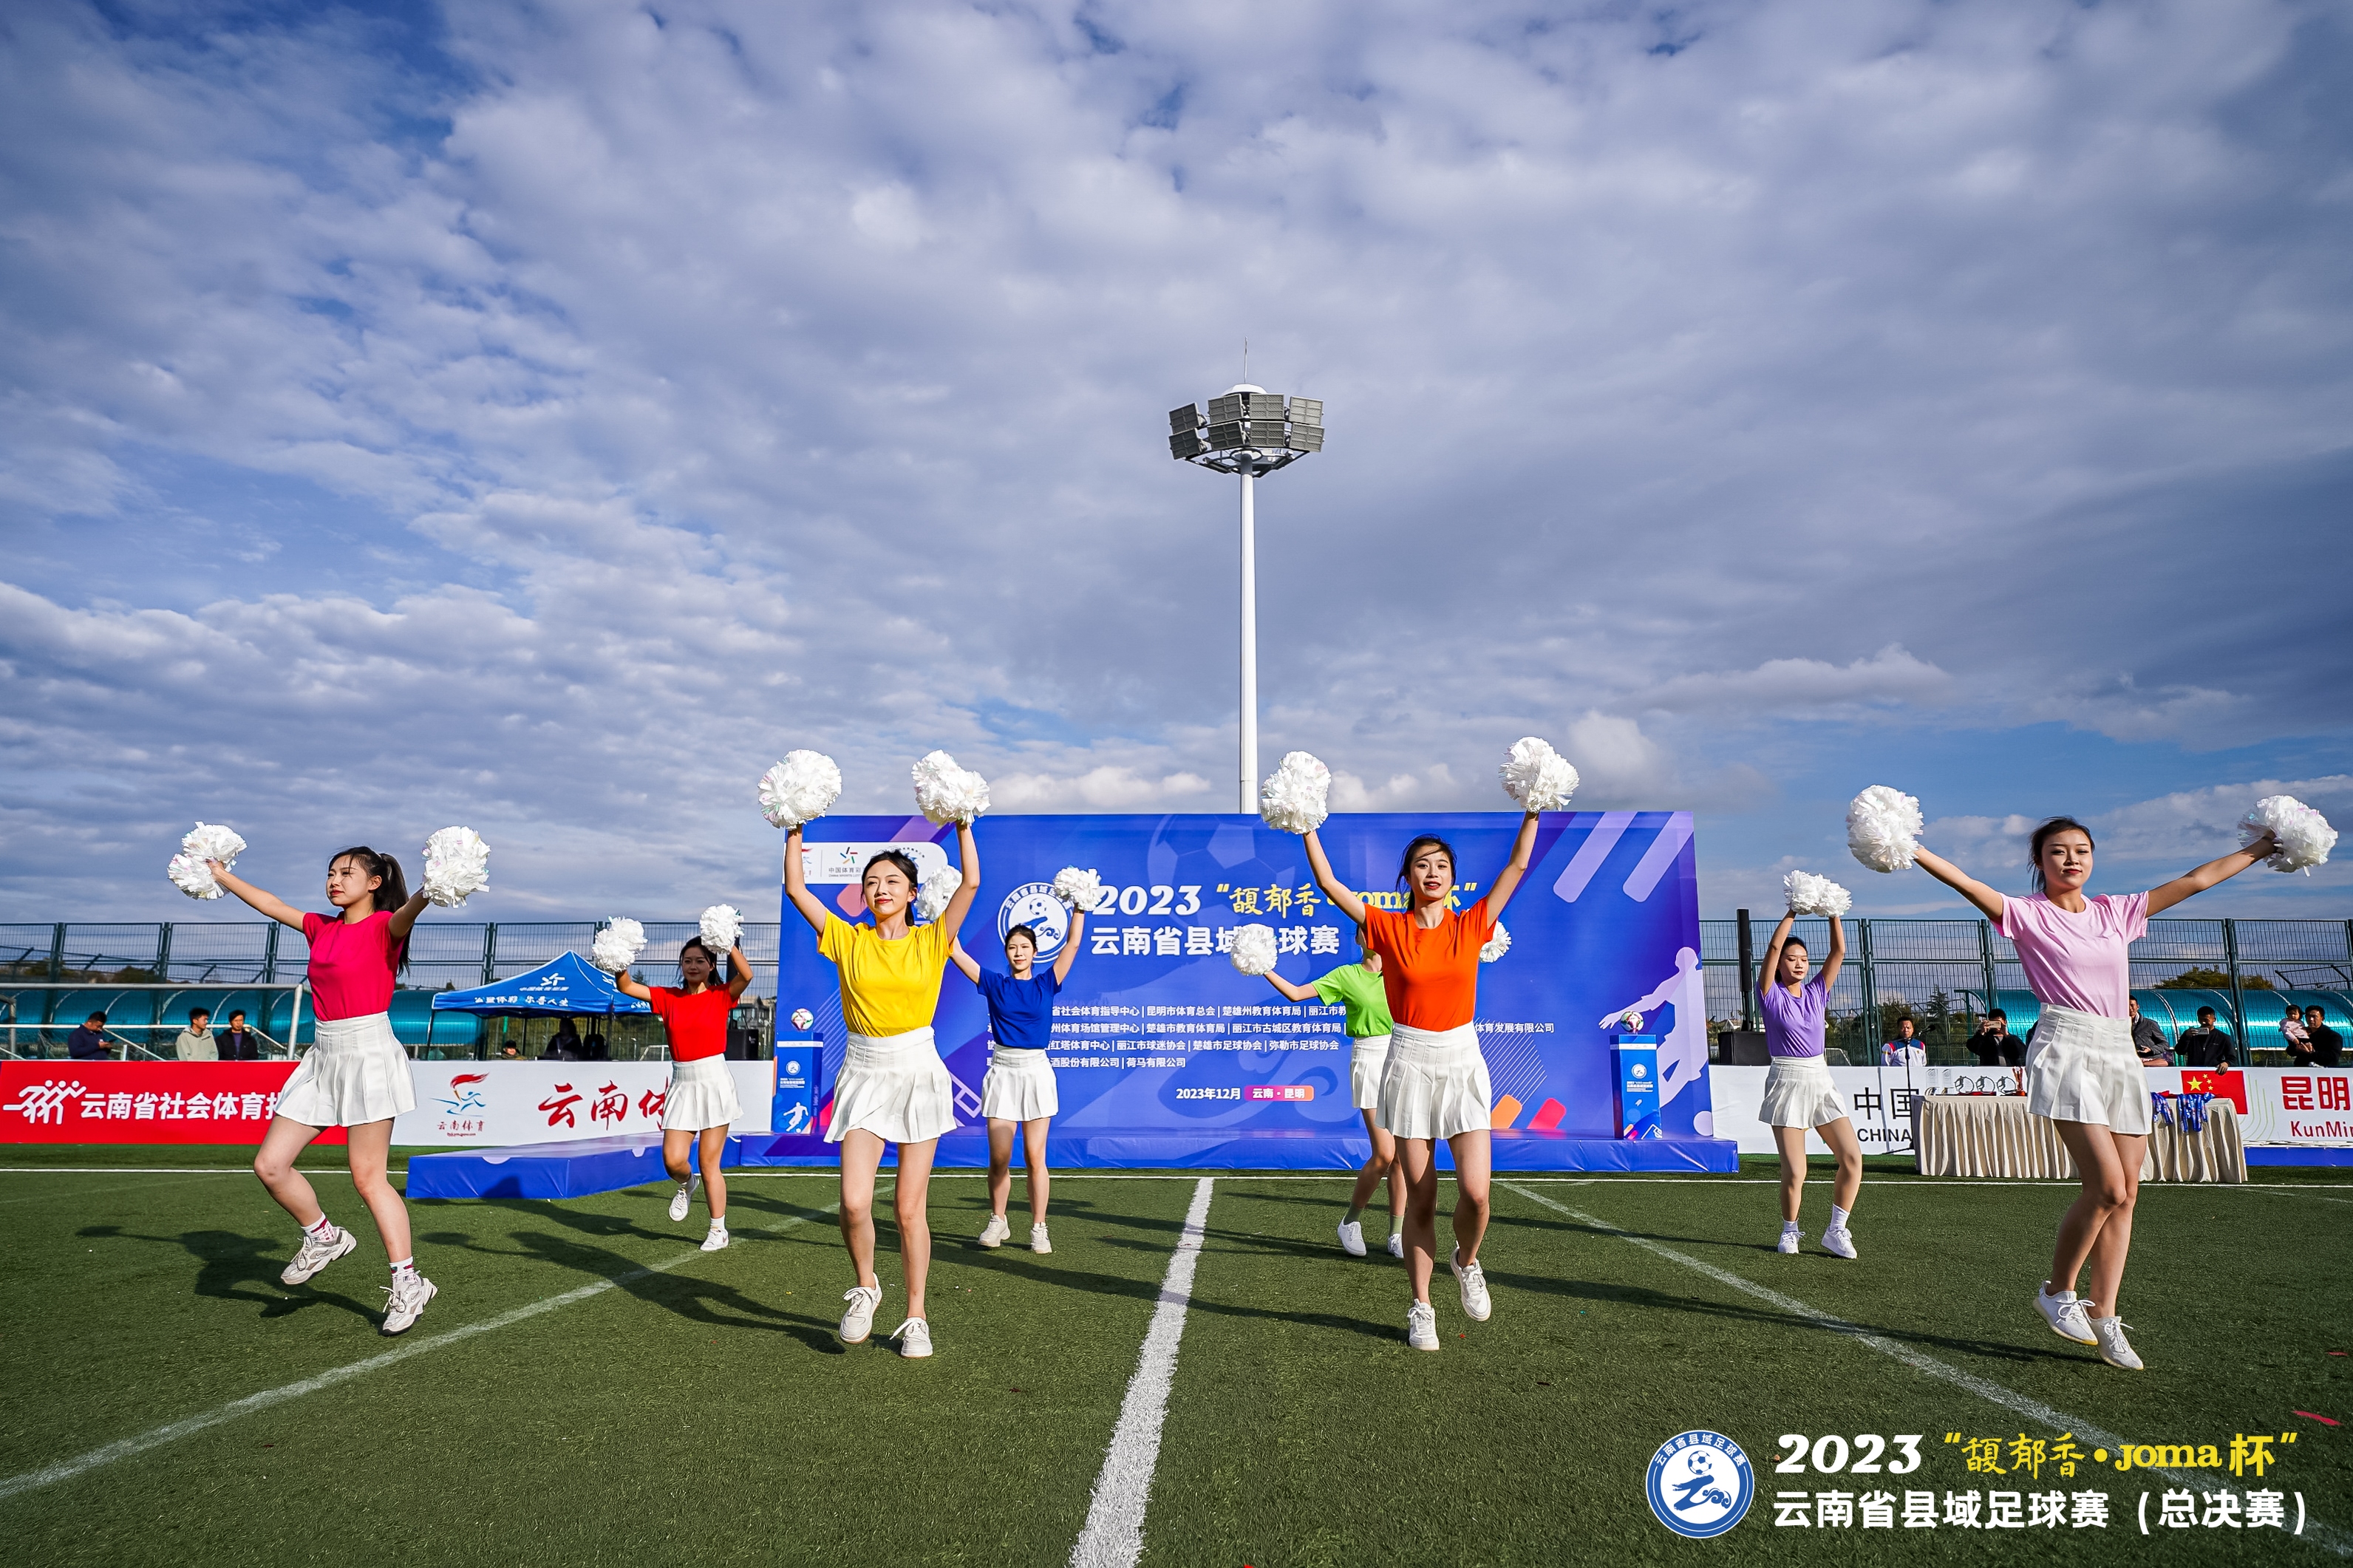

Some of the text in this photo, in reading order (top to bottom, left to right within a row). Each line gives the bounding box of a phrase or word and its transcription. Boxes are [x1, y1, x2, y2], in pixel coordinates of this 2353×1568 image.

[1092, 885, 1202, 916] 2023
[1091, 925, 1339, 955] 云南省县域球赛
[1147, 1006, 1216, 1017] 昆明市体育总会
[1222, 1006, 1301, 1017] 楚雄州教育体育局
[1146, 1023, 1225, 1034] 楚雄市教育体育局
[1232, 1023, 1341, 1034] 丽江市古城区教育体育局
[1117, 1040, 1186, 1051] 丽江市球迷协会
[1193, 1040, 1262, 1051] 楚雄市足球协会
[1269, 1040, 1339, 1051] 弥勒市足球协会
[1126, 1057, 1186, 1068] 荷马有限公司
[1176, 1088, 1241, 1100] 2023年12月
[2281, 1077, 2351, 1111] 昆明
[1853, 1087, 1919, 1119] 中国
[1857, 1128, 1913, 1142] CHINA
